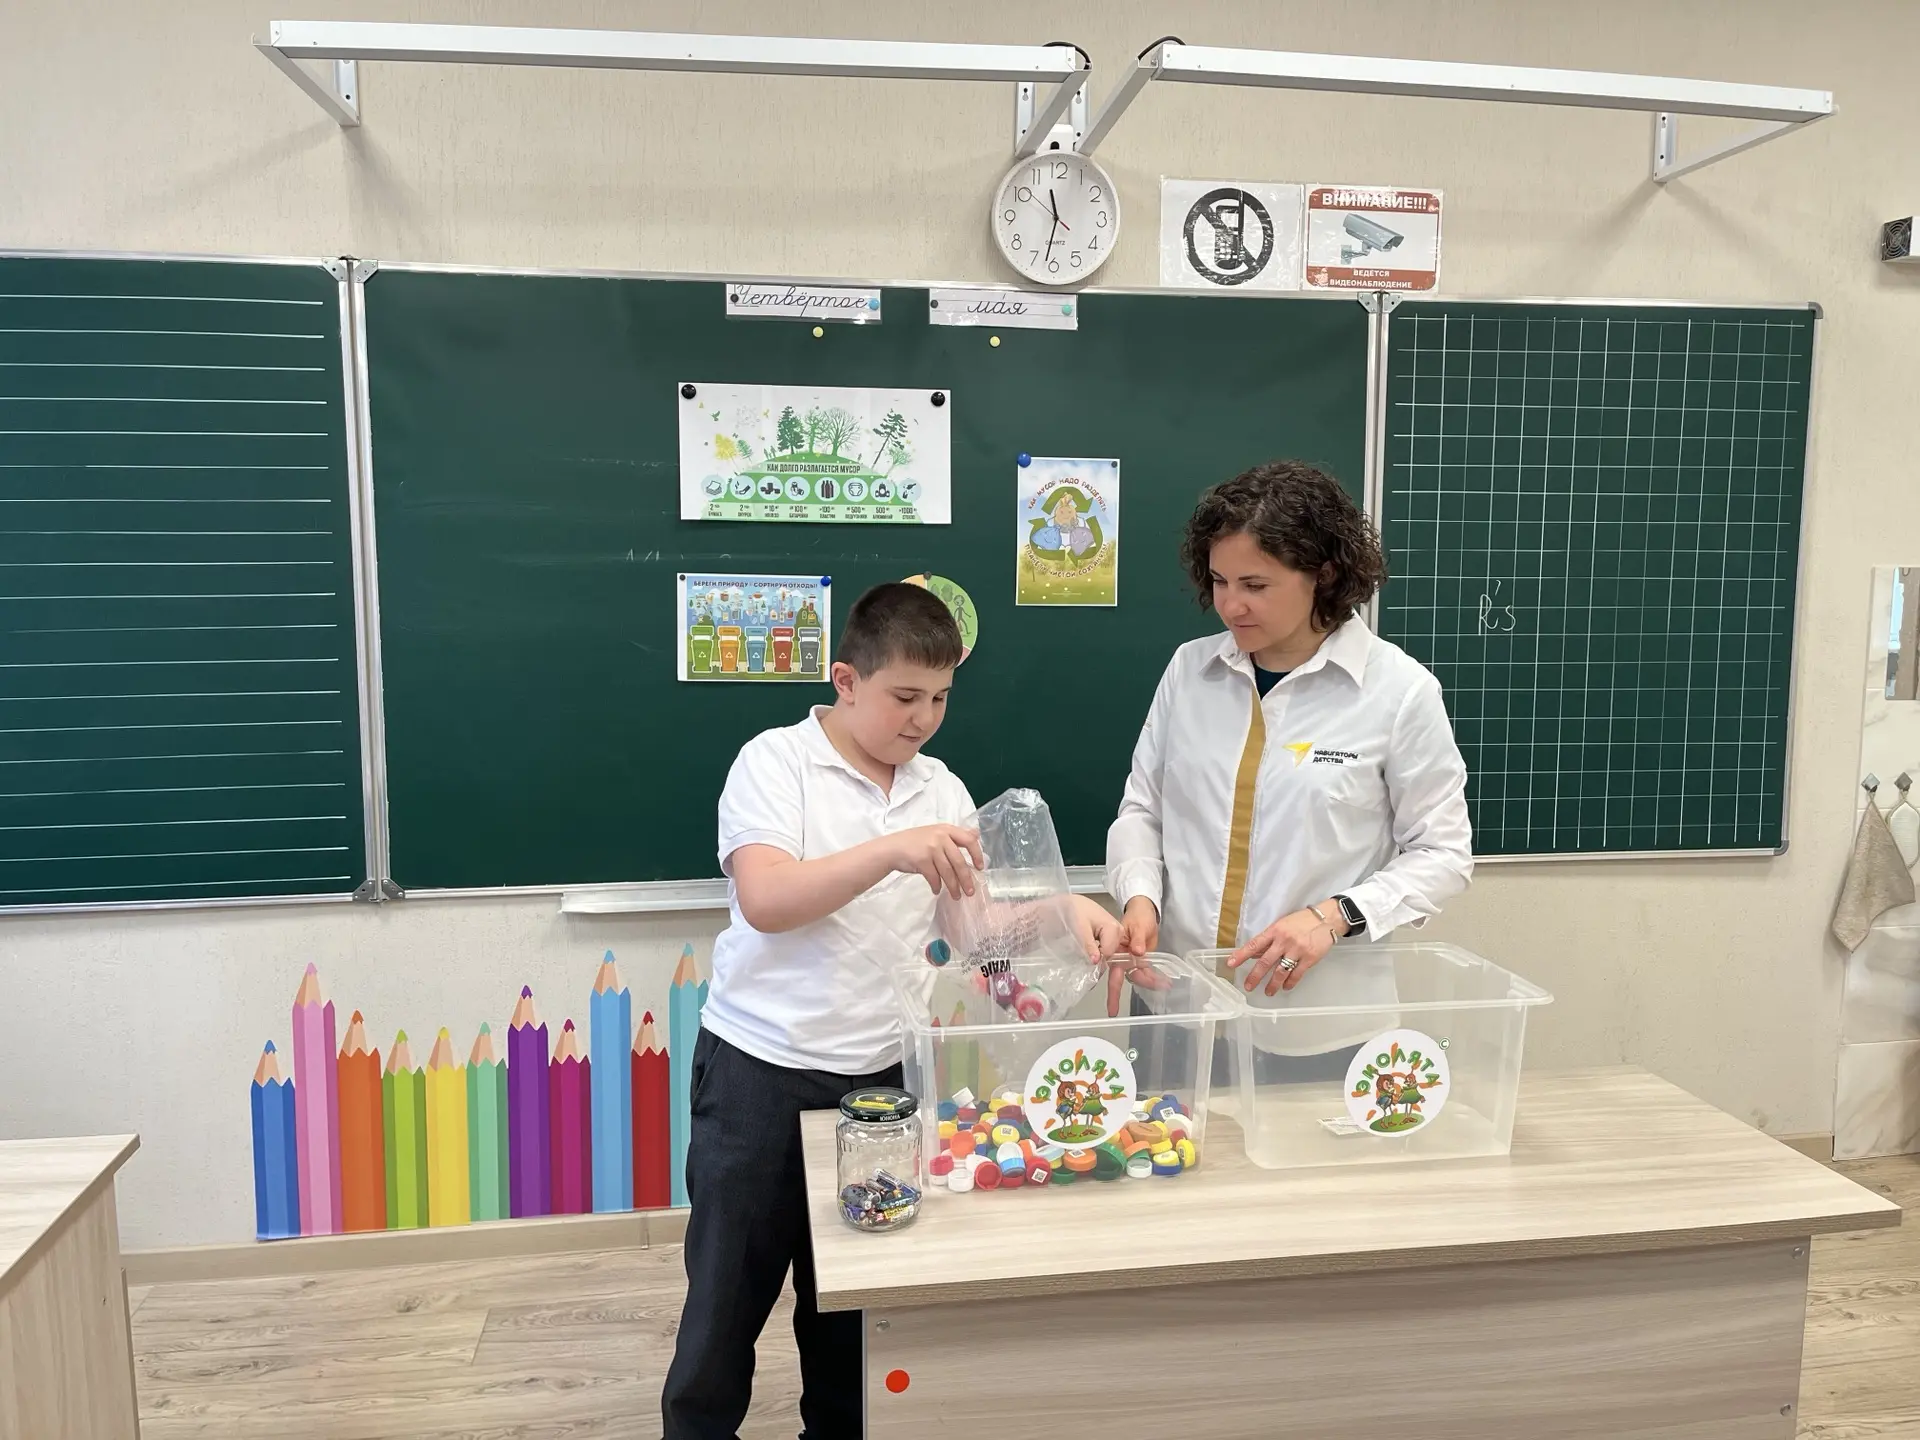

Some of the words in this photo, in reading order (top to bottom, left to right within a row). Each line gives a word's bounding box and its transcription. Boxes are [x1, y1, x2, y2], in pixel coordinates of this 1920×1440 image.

[1032, 168, 1040, 185] 11
[1050, 162, 1068, 179] 12
[1014, 186, 1032, 202] 10
[1089, 185, 1102, 202] 2
[1322, 192, 1427, 209] ВНИМАНИЕ!!!
[1004, 209, 1016, 225] 9
[1096, 210, 1107, 228] 3
[1011, 233, 1022, 250] 8
[1088, 235, 1098, 250] 4
[1030, 250, 1039, 266] 7
[1048, 257, 1059, 273] 6
[1070, 251, 1081, 267] 5
[1329, 279, 1412, 289] ВИДЕОНАБЛЮДЕНИЕ
[767, 464, 778, 472] КАК
[780, 464, 798, 473] ДОЛГО
[800, 464, 838, 473] РАЗЛАГАЕТСЯ
[840, 465, 860, 474] МУСОР
[1314, 750, 1358, 759] НАВИГАТОРЫ
